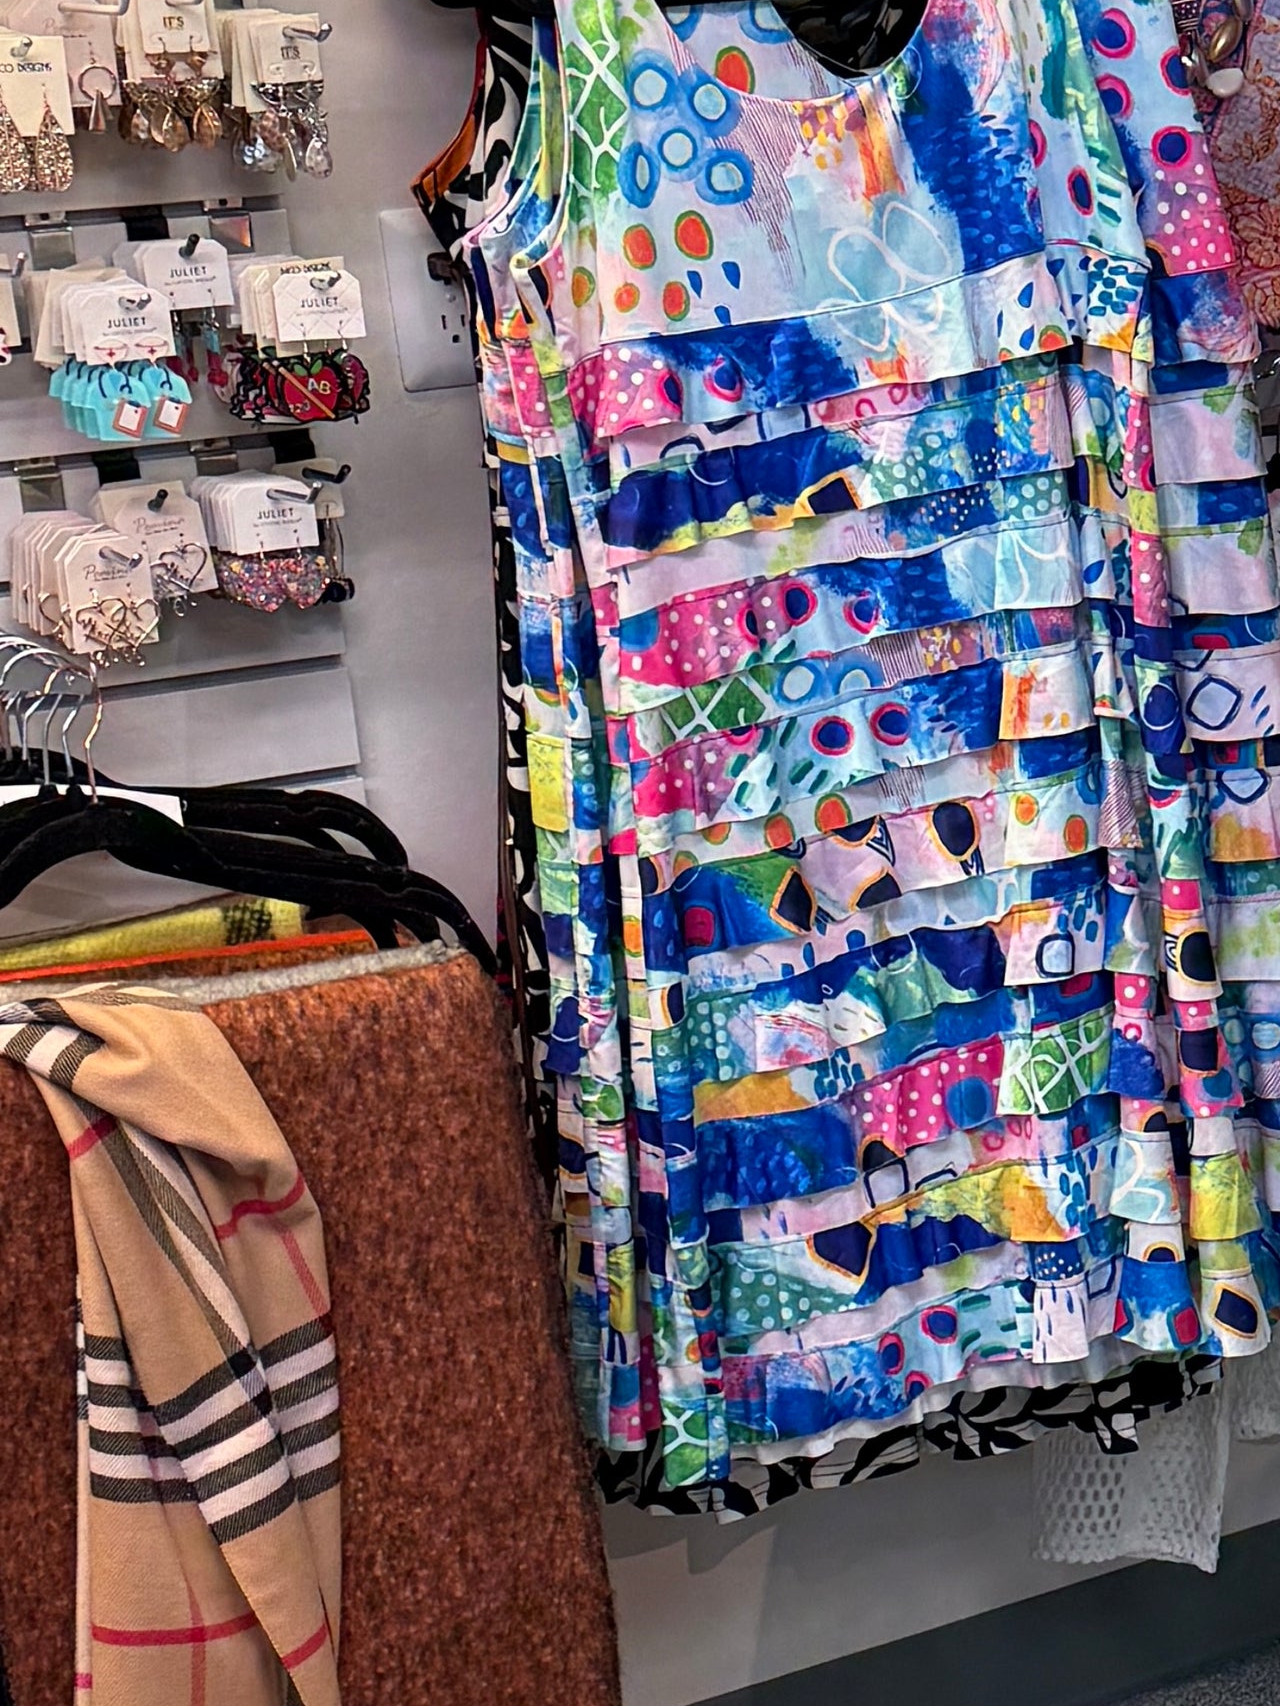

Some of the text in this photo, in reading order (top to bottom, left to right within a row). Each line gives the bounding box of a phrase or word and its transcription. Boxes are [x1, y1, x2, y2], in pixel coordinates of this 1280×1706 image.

[170, 266, 208, 279] JULIET
[300, 296, 339, 309] JULIET
[107, 317, 147, 329] JULIET
[257, 506, 295, 521] JULIET
